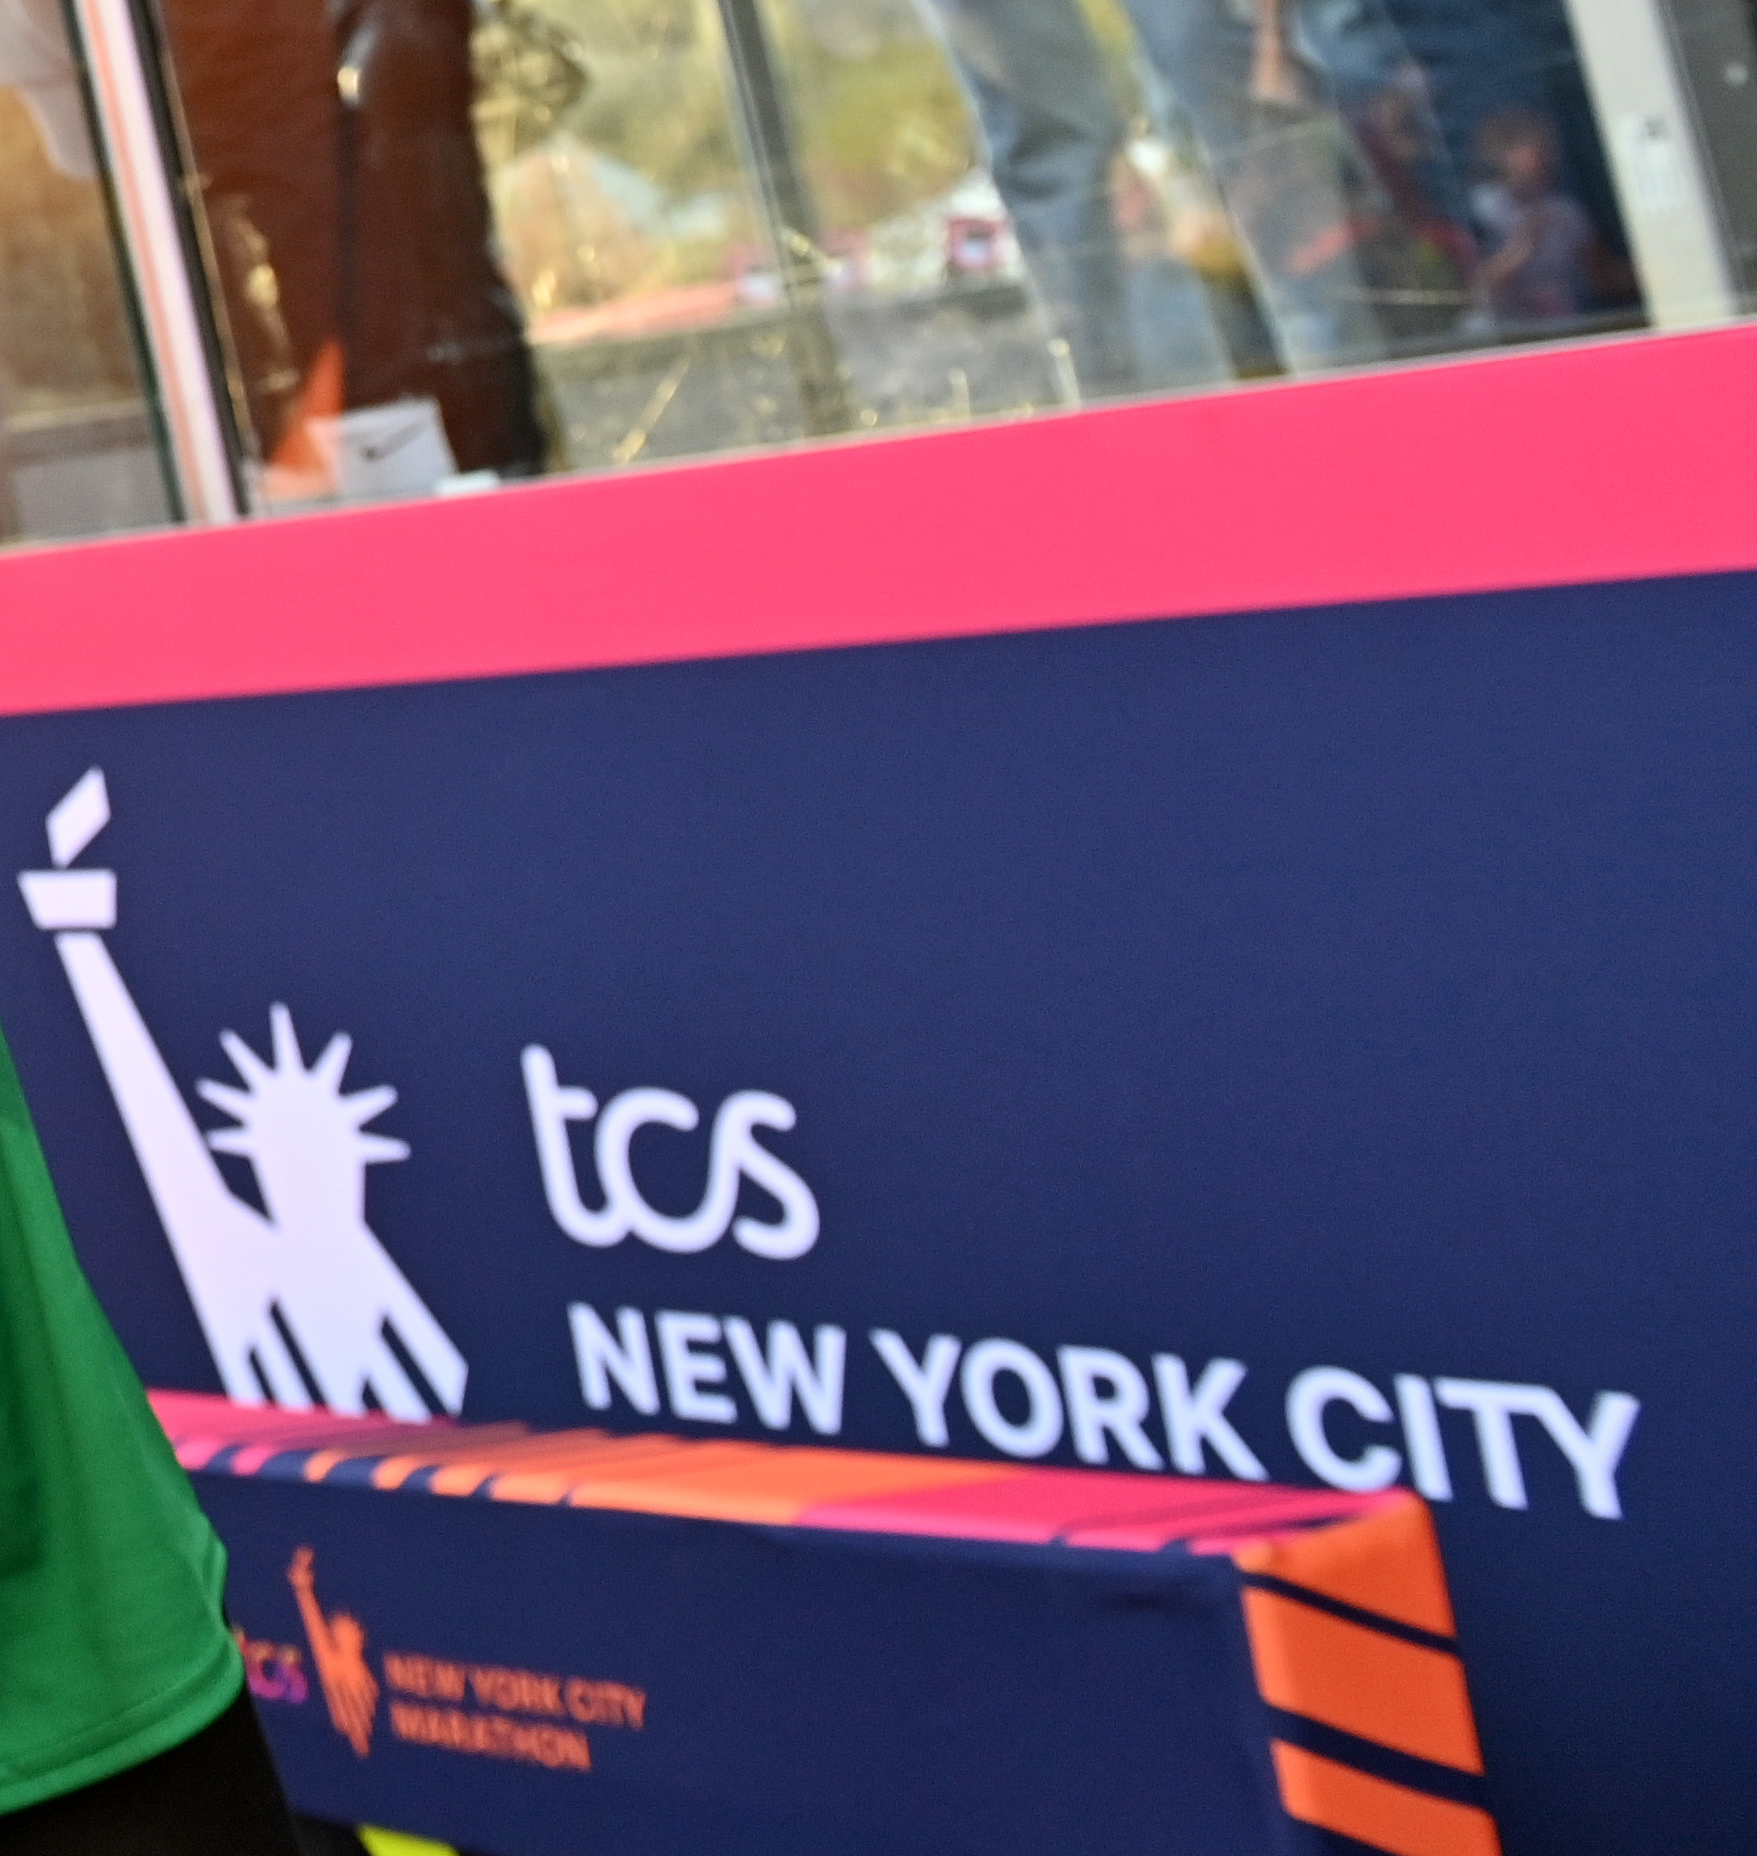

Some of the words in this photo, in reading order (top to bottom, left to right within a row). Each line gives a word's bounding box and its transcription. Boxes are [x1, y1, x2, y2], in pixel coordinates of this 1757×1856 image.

[521, 1044, 820, 1260] tcs
[567, 1302, 847, 1437] NEW
[871, 1330, 1271, 1482] YORK
[1286, 1366, 1640, 1520] CITY
[383, 1651, 466, 1702] NEW
[468, 1662, 566, 1717] YORK
[565, 1674, 647, 1731] CITY
[389, 1699, 593, 1774] MARATHON
